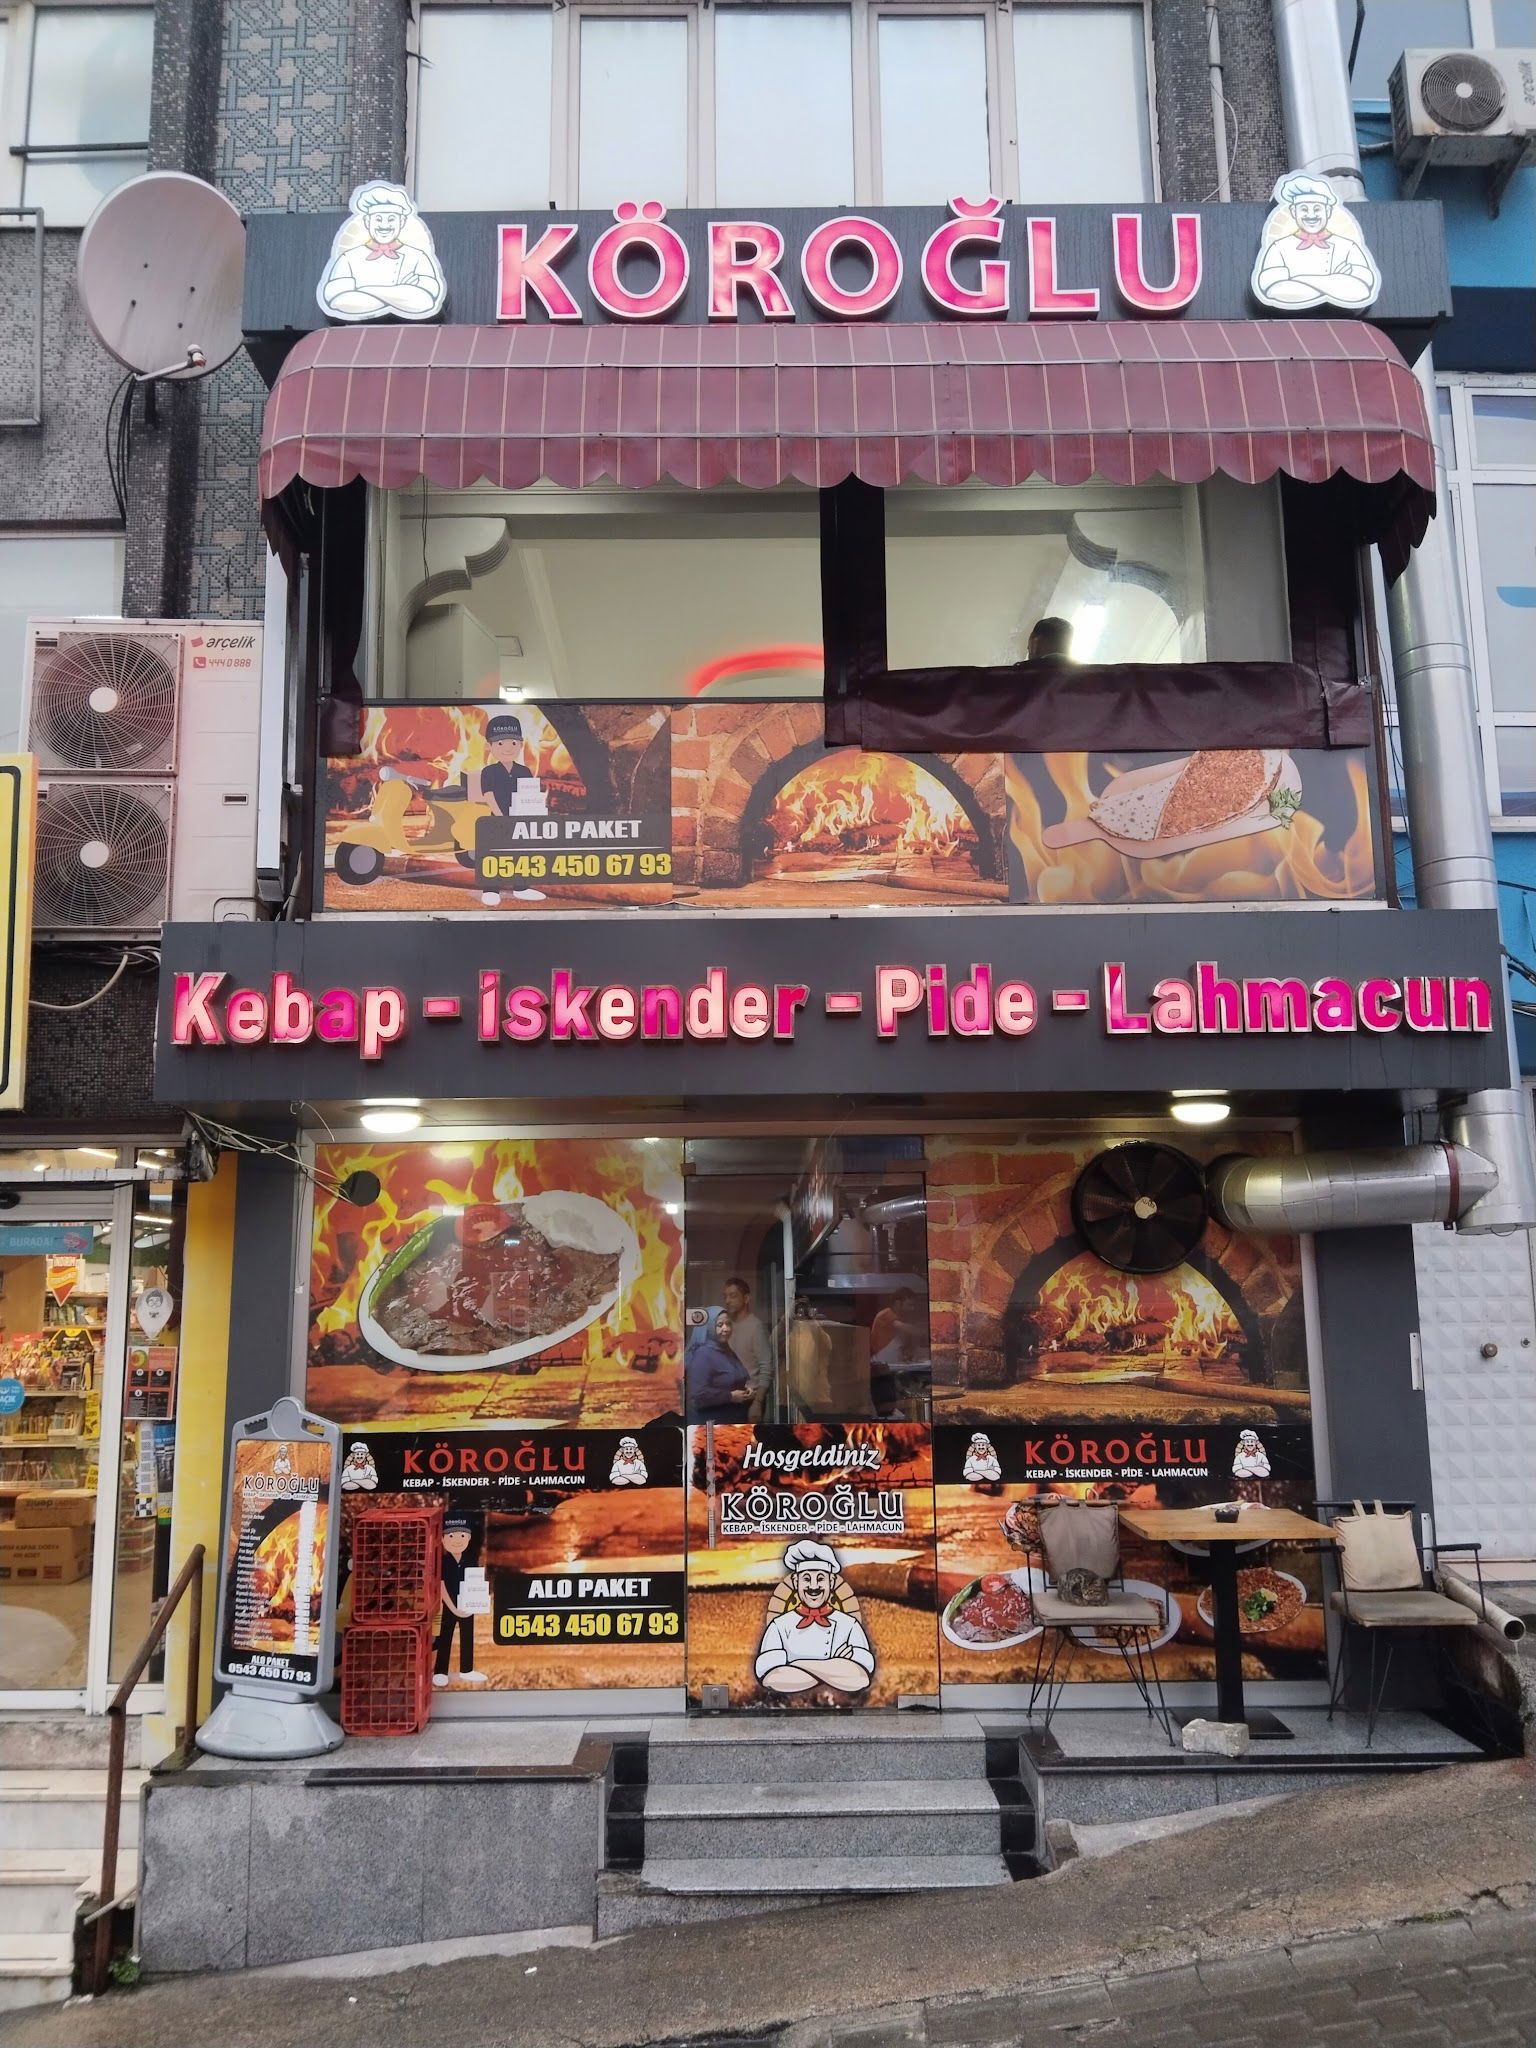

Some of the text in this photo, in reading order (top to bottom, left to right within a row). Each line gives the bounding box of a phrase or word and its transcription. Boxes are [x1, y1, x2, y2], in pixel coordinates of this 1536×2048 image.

[496, 196, 1203, 322] KÖROĞLU
[206, 636, 256, 651] arçelik
[511, 820, 642, 840] ALO PAKET
[481, 853, 672, 877] 0543 450 67 93
[171, 971, 408, 1060] Kebap
[478, 966, 811, 1041] iskender
[875, 963, 1039, 1036] Pide
[1104, 961, 1493, 1034] Lahmacun
[403, 1440, 585, 1474] KÖROĞLU
[743, 1442, 881, 1471] Hoşgeldiniz
[1025, 1432, 1207, 1465] KÖROĞLU
[243, 1472, 320, 1493] KÖROĞLU
[403, 1478, 434, 1487] KEBAP
[442, 1475, 489, 1487] İSKENDER
[498, 1475, 521, 1486] PİDE
[529, 1475, 585, 1486] LAHMACUN
[1026, 1469, 1057, 1479] KEBAP
[1065, 1466, 1112, 1478] İSKENDER
[1121, 1466, 1143, 1477] PİDE
[1152, 1467, 1208, 1477] LAHMACUN
[721, 1484, 904, 1521] KÖROĞLU
[722, 1523, 753, 1533] KEBAP
[761, 1521, 808, 1532] İSKENDER
[817, 1521, 838, 1531] PİDE
[847, 1521, 903, 1532] LAHMACUN
[527, 1578, 652, 1599] ALO PAKET
[500, 1612, 679, 1638] 0543 450 67 93
[251, 1655, 290, 1668] ALO PAKET
[228, 1663, 311, 1682] 0543 450 67 93
